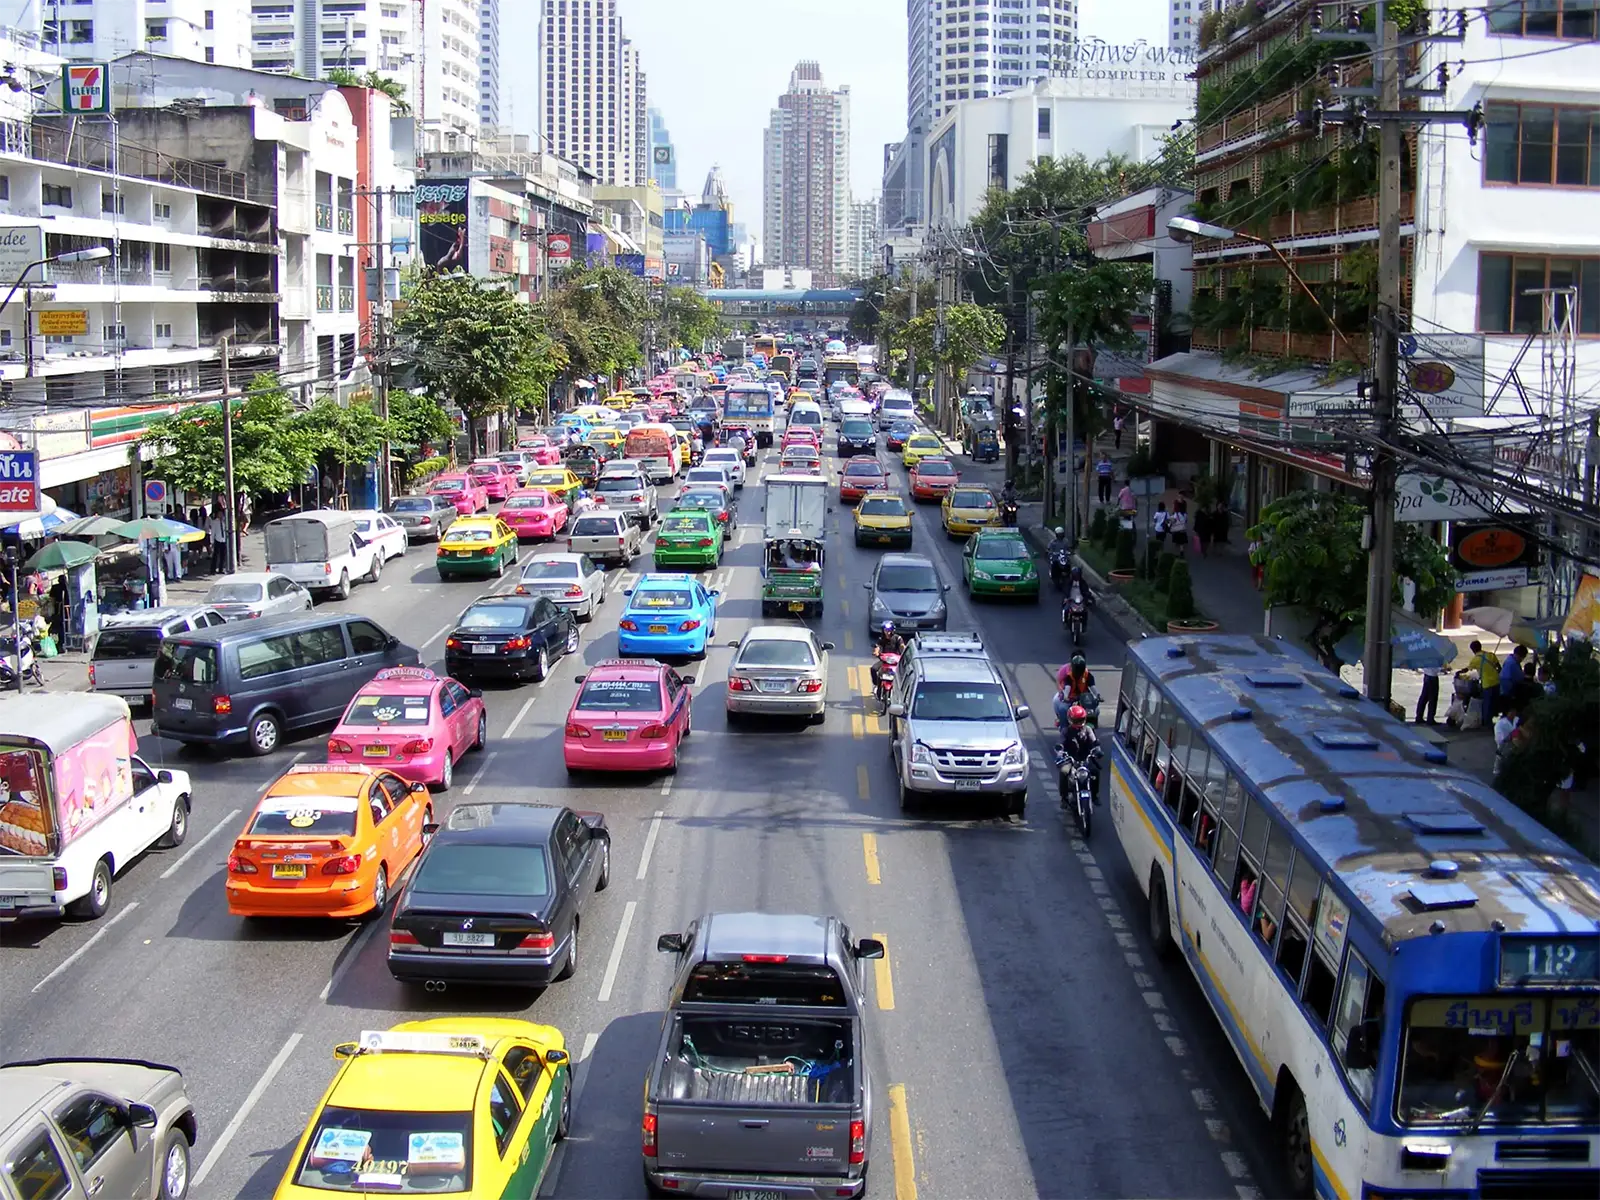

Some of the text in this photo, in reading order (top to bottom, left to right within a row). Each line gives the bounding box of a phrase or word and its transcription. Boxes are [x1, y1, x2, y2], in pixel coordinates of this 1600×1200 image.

[1051, 69, 1078, 78] THE
[1087, 70, 1165, 80] COMPUTER
[71, 67, 99, 109] 7
[1421, 396, 1465, 405] ESIDENCE
